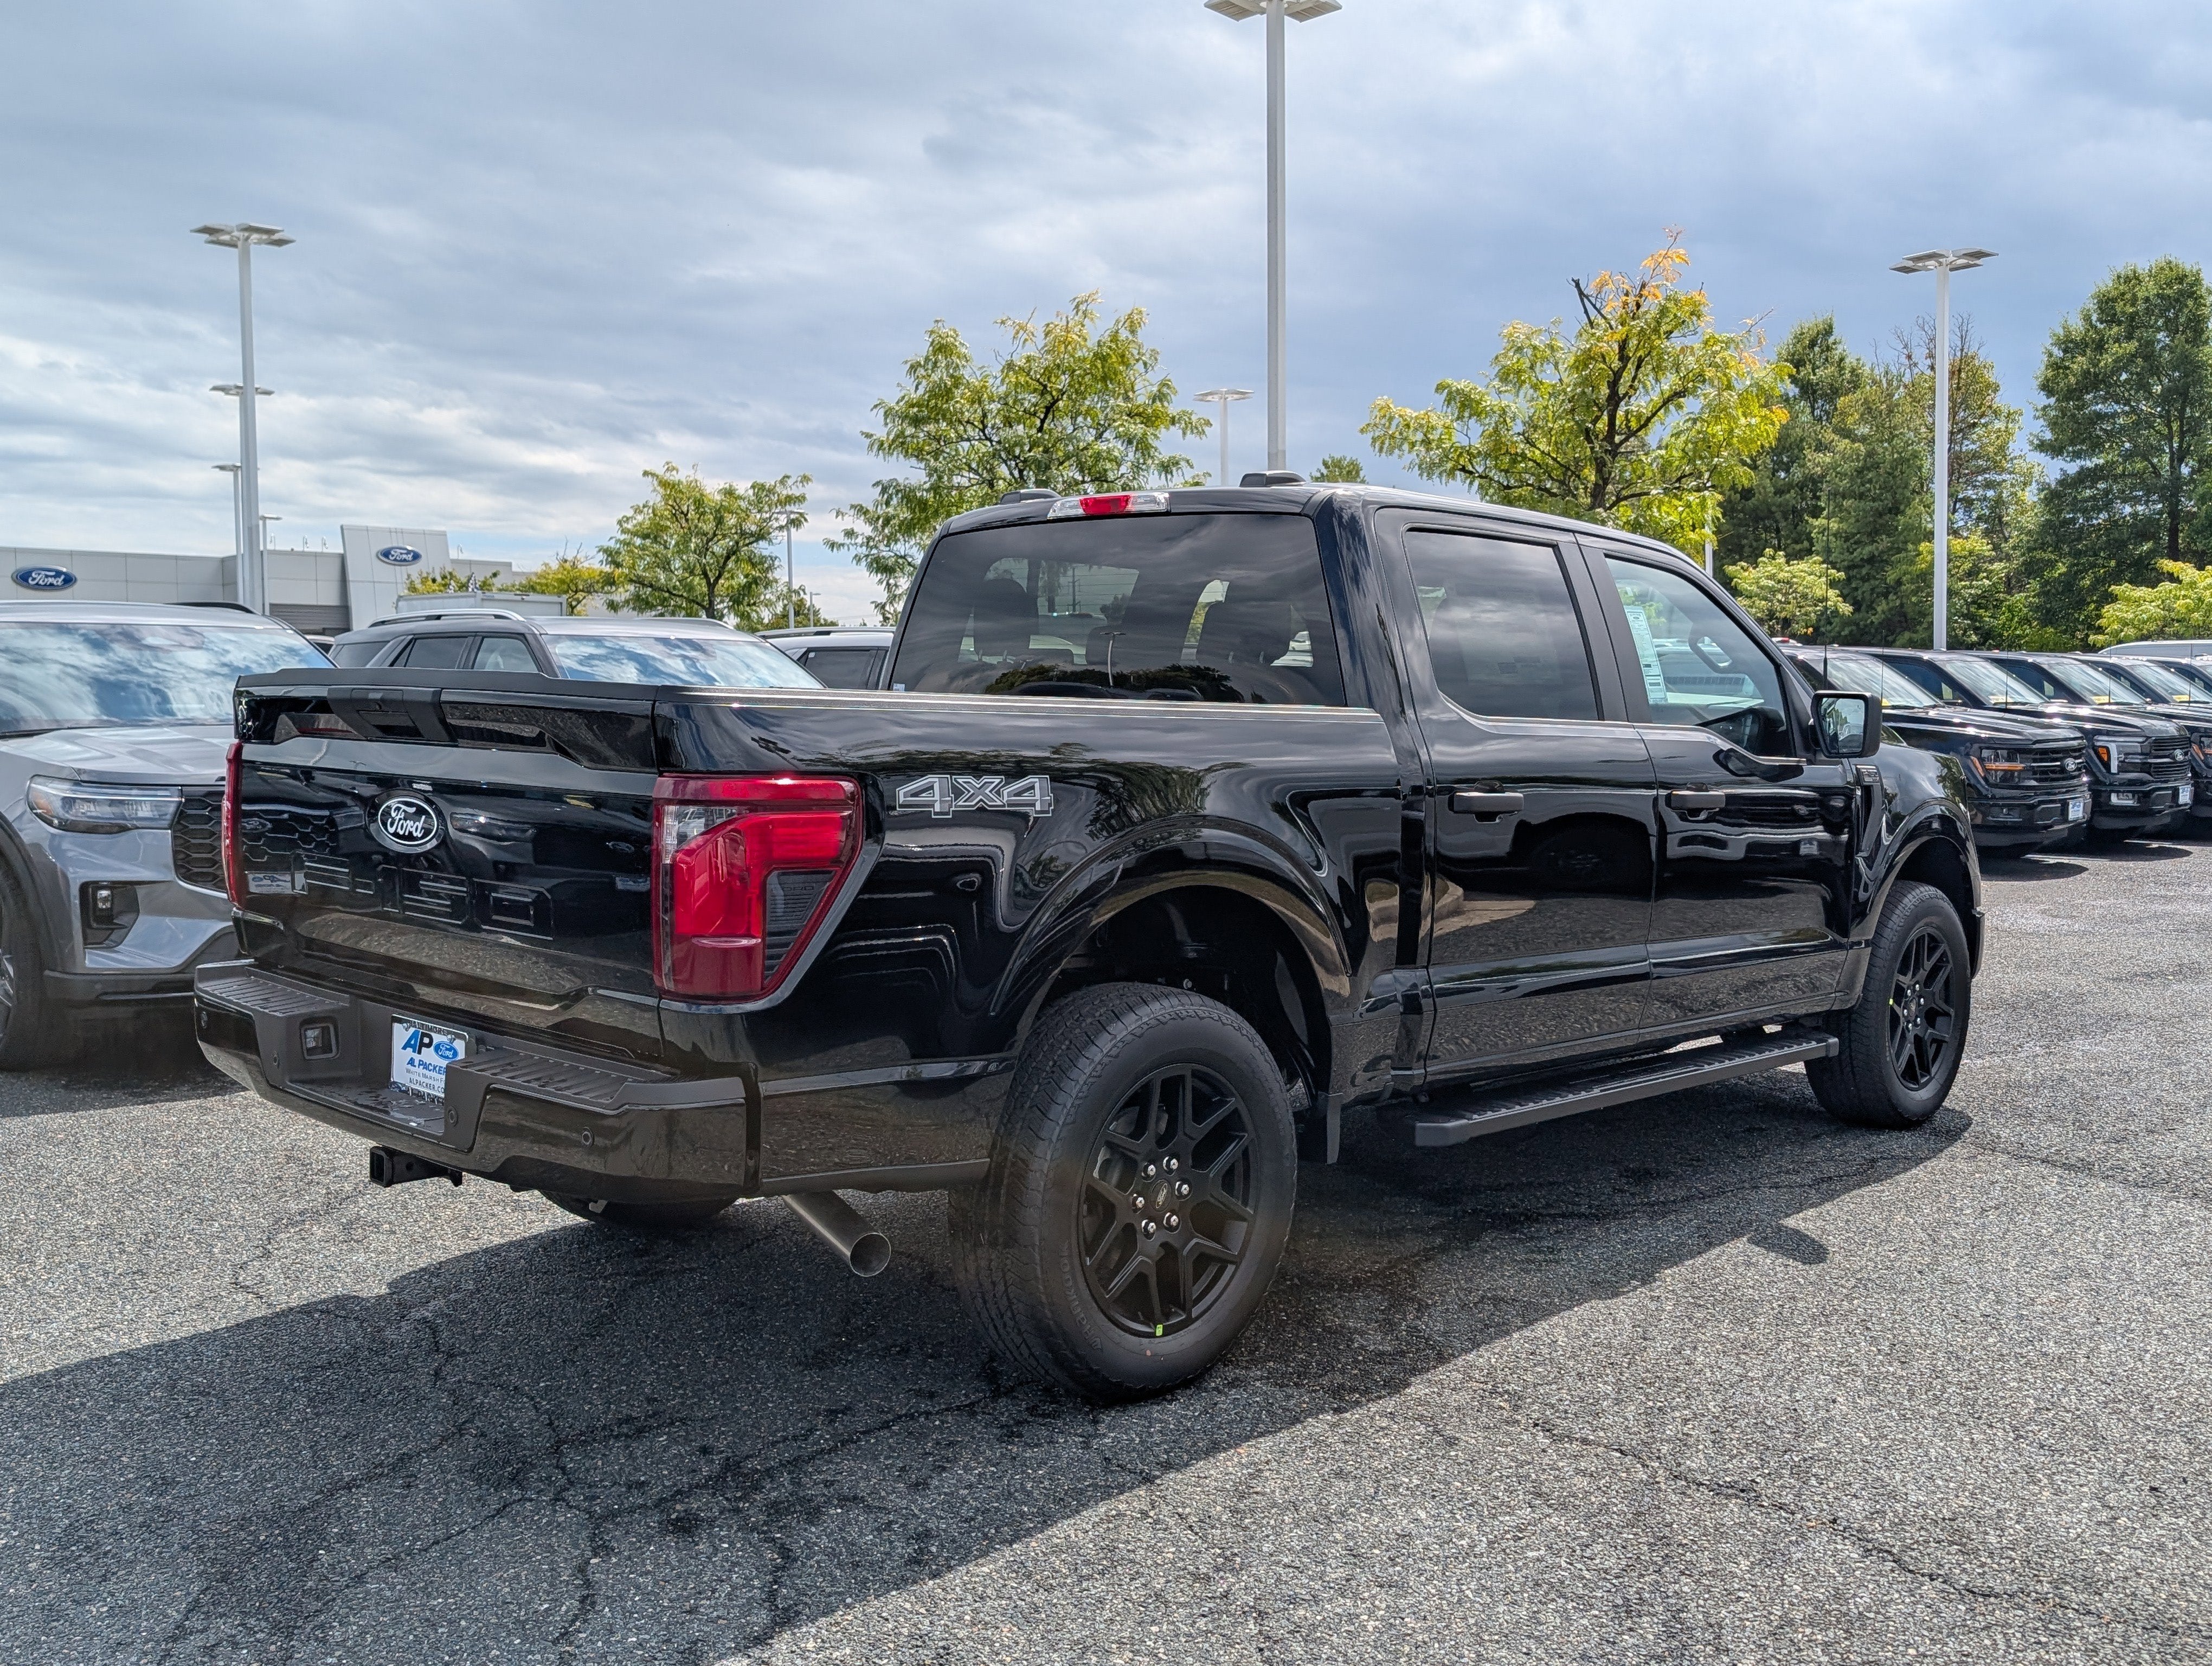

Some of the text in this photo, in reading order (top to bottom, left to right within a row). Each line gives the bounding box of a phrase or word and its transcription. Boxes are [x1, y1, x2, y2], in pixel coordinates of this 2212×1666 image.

[389, 548, 414, 561] Ford
[28, 570, 65, 586] Ford
[387, 803, 426, 838] Ford
[401, 1030, 433, 1055] AP
[438, 1043, 454, 1058] Ford
[407, 1057, 416, 1068] AL
[409, 1078, 445, 1094] ALPACKER.CO
